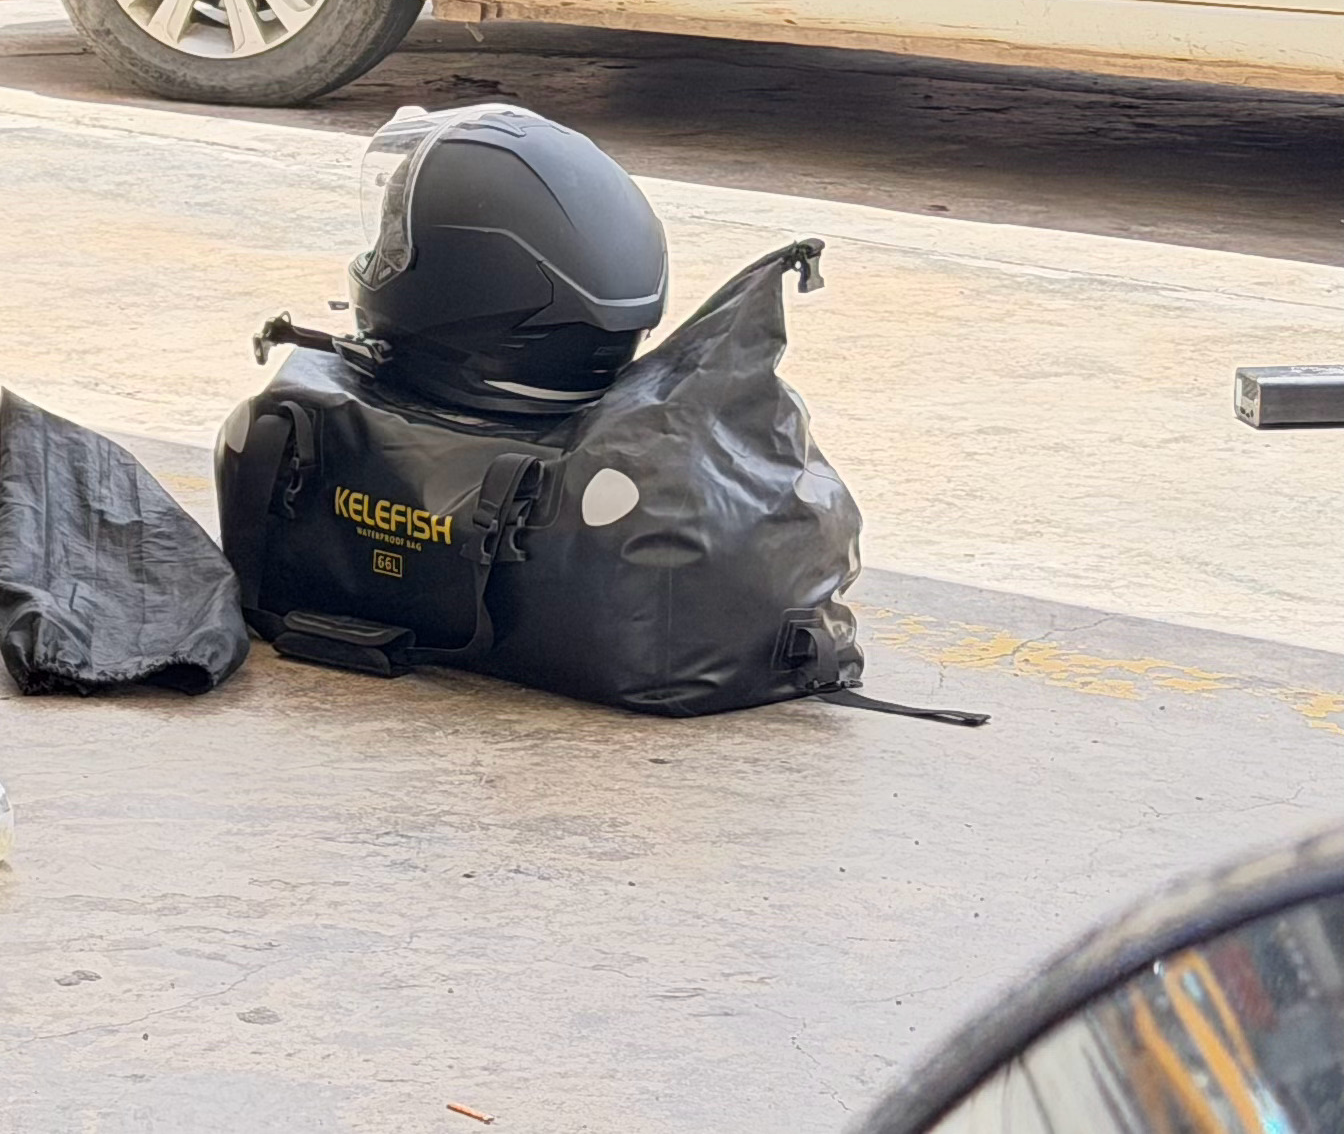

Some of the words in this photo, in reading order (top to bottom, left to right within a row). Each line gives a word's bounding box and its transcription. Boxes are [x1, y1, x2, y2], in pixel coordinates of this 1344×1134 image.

[334, 485, 453, 545] KELEFISH
[356, 526, 405, 548] WATERPROOF
[377, 554, 399, 573] 66L
